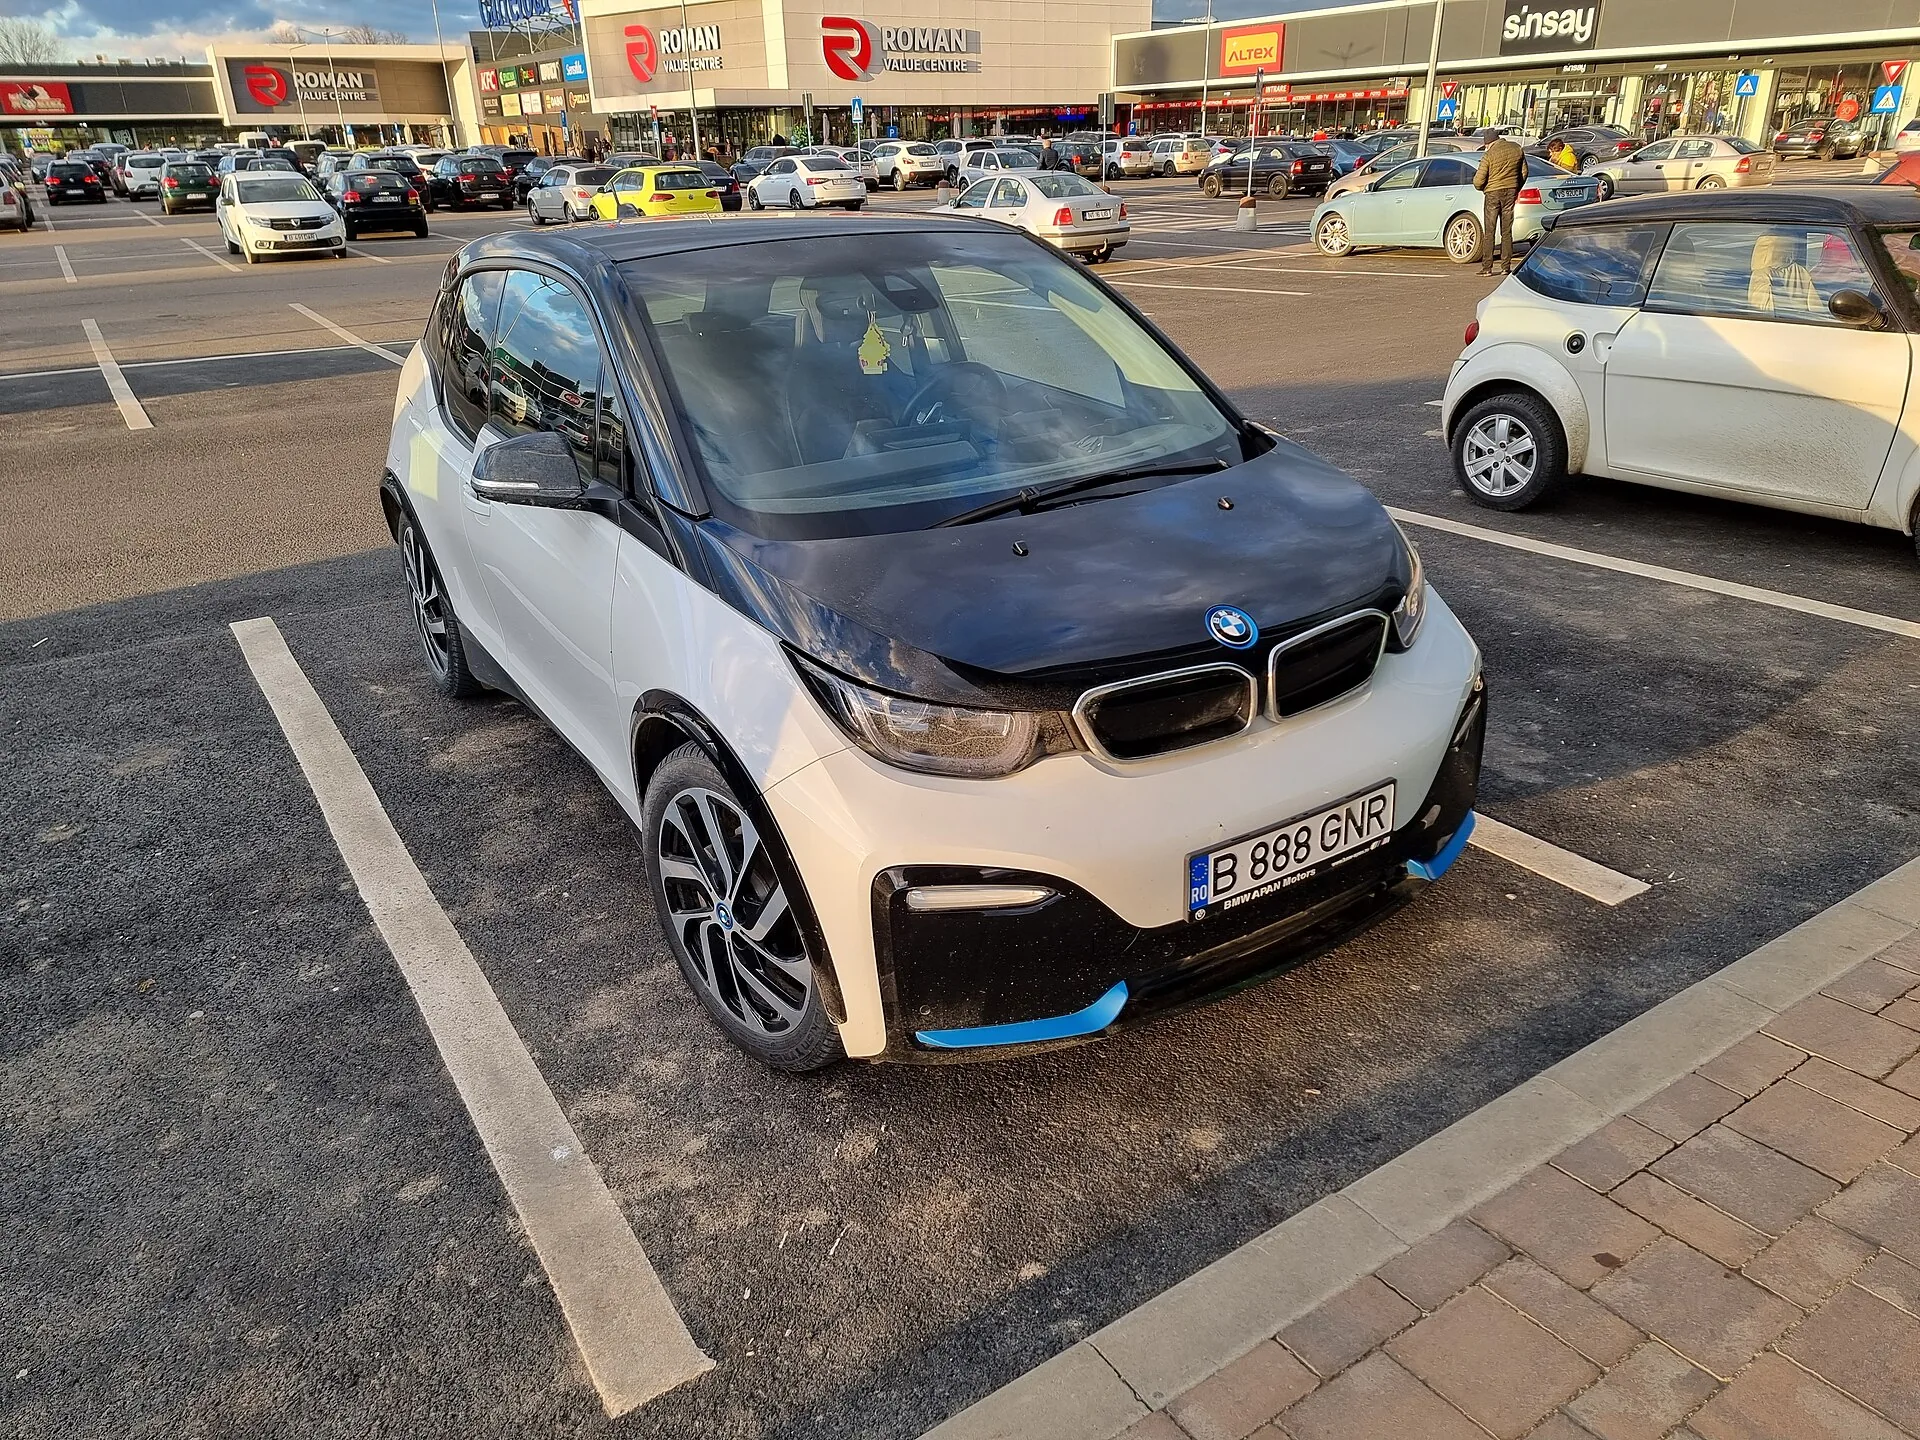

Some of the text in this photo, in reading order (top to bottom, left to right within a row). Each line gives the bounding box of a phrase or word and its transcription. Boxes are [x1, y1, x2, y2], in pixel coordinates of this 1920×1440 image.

[1503, 5, 1595, 42] sinsay
[660, 25, 720, 54] ROMAN
[881, 26, 967, 52] ROMAN
[663, 56, 722, 73] VALUE CENTRE
[883, 58, 968, 71] VALUE CENTRE
[293, 71, 364, 88] ROMAN
[480, 70, 498, 91] KFC
[329, 91, 367, 101] CENTRE
[1212, 794, 1387, 897] B 888 GNR
[1282, 868, 1316, 888] Motors
[1191, 884, 1208, 904] RO
